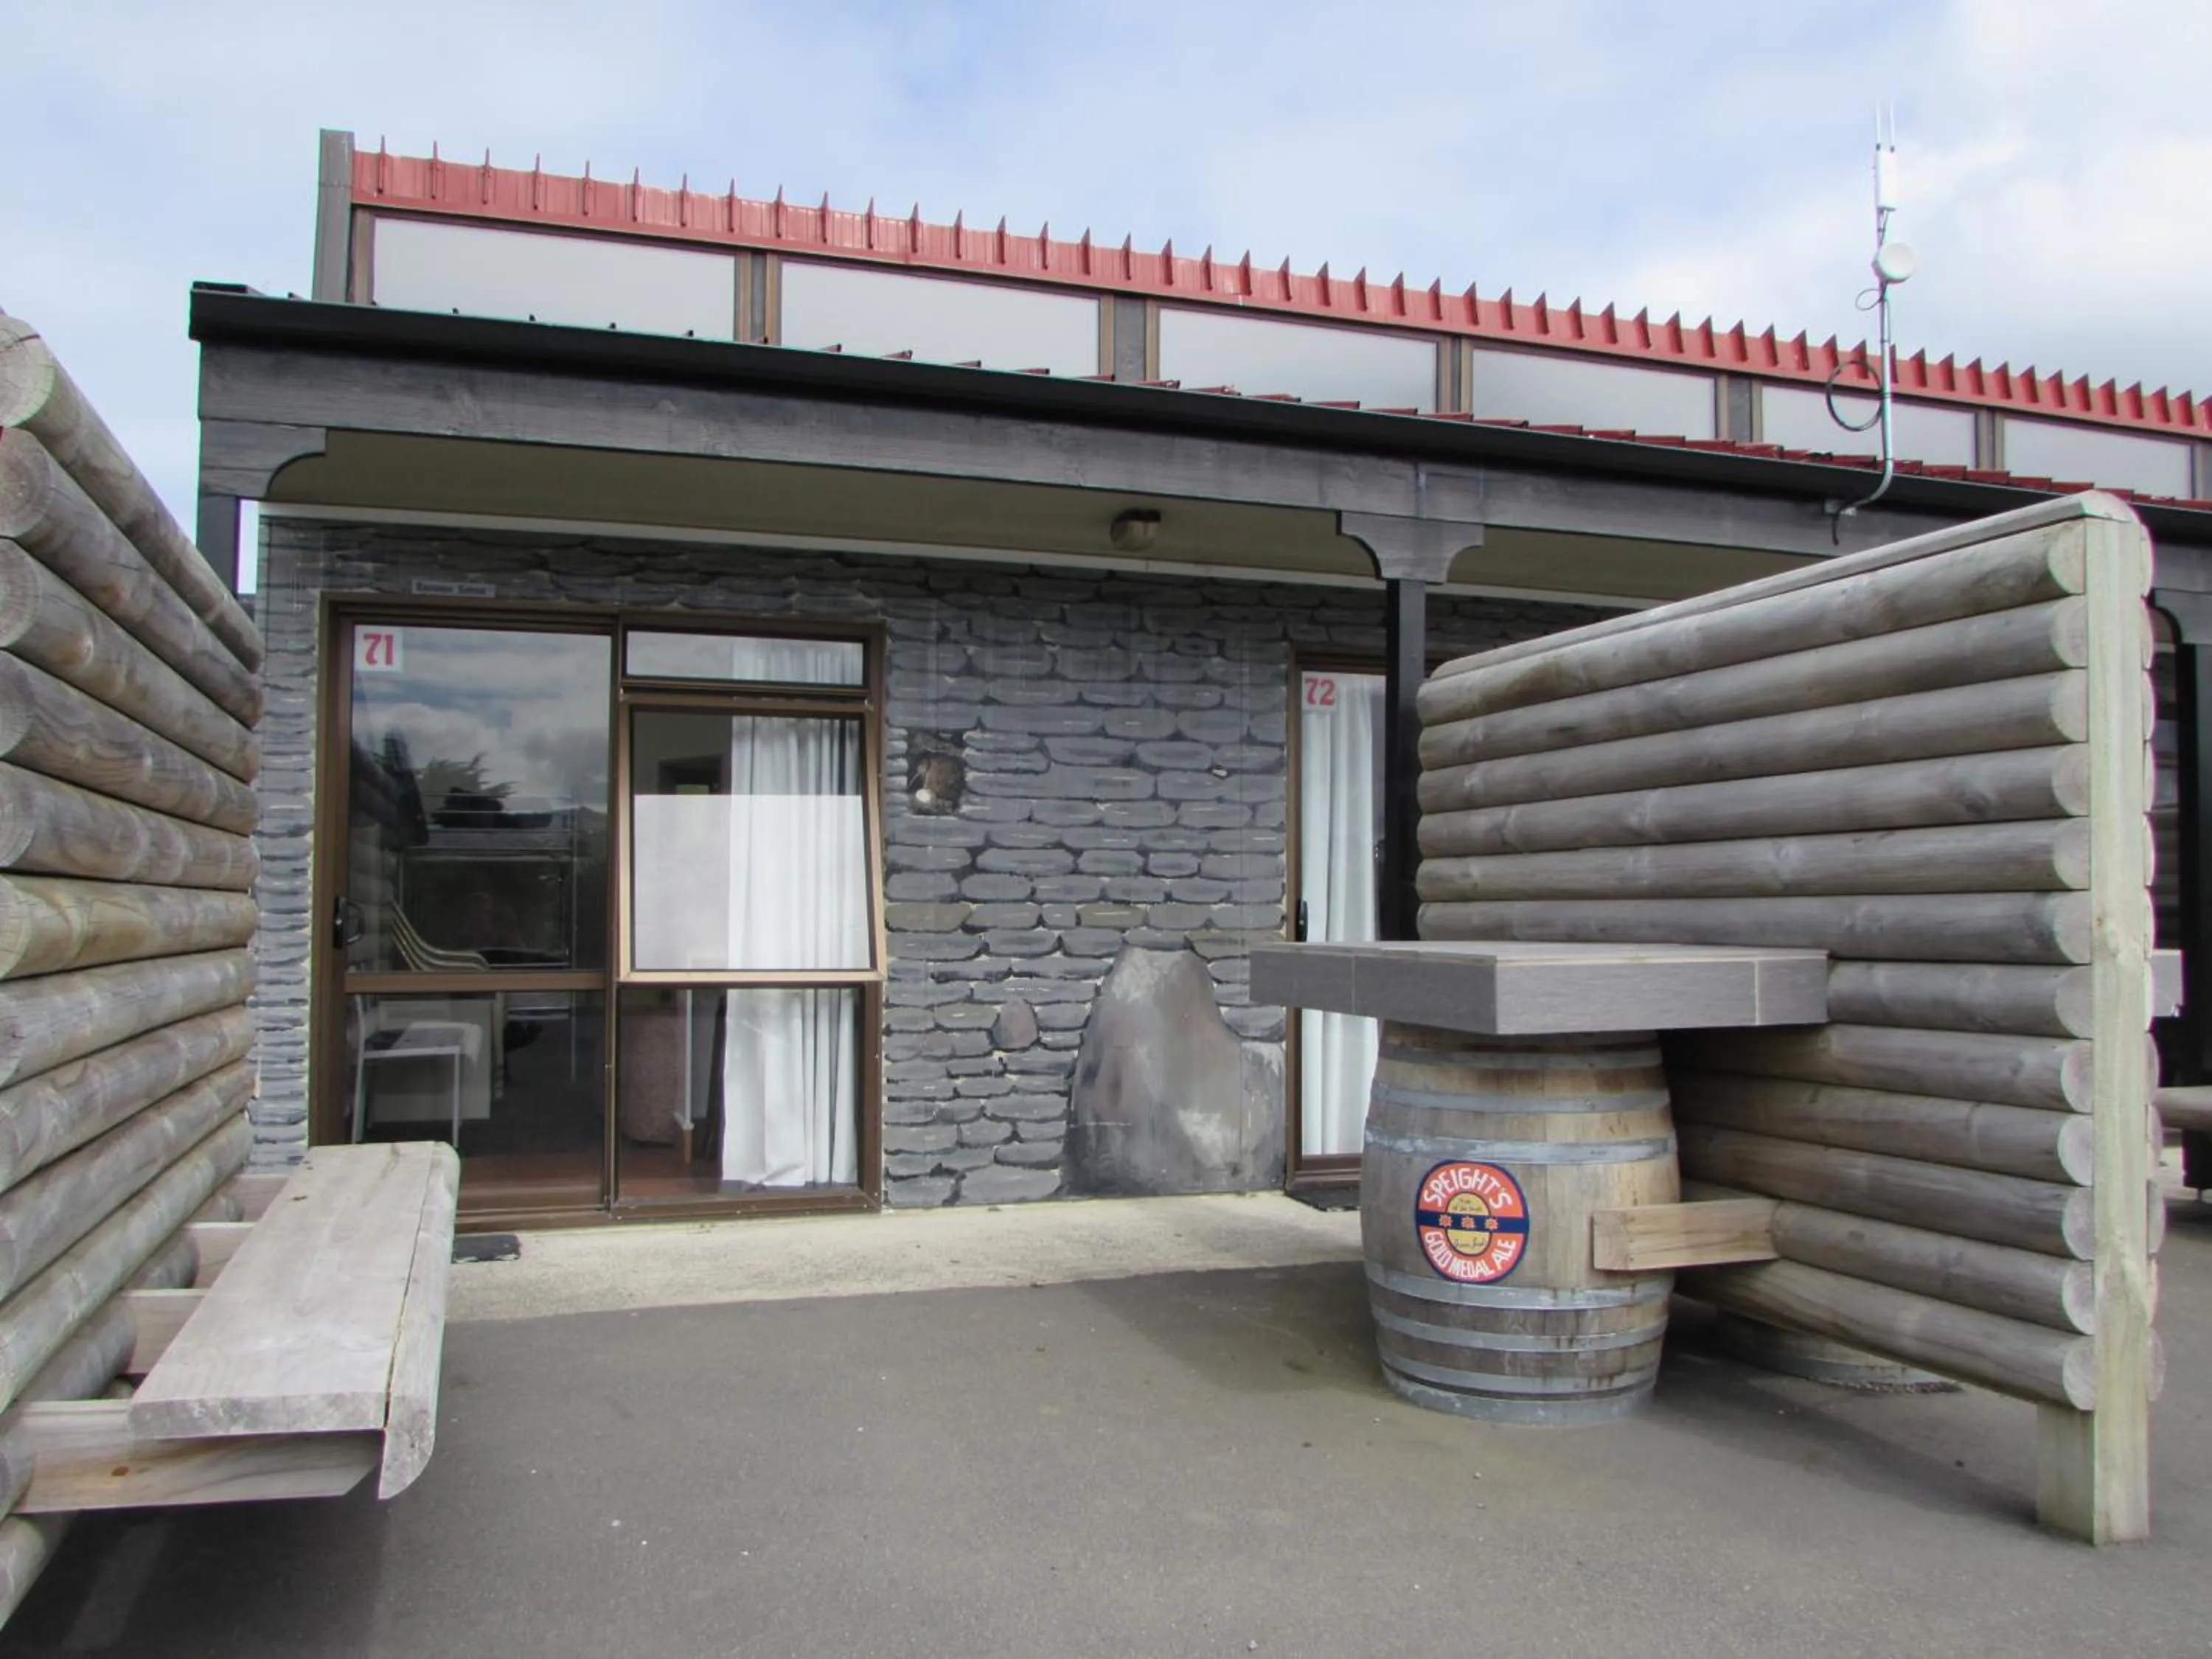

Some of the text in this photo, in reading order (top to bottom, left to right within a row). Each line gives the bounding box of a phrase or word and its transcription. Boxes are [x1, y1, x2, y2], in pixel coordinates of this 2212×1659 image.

[364, 634, 394, 666] 71
[1304, 677, 1335, 706] 72
[1424, 1168, 1512, 1208] SPEIGHT'S
[1425, 1231, 1517, 1278] GOLD MEDAL ALE
